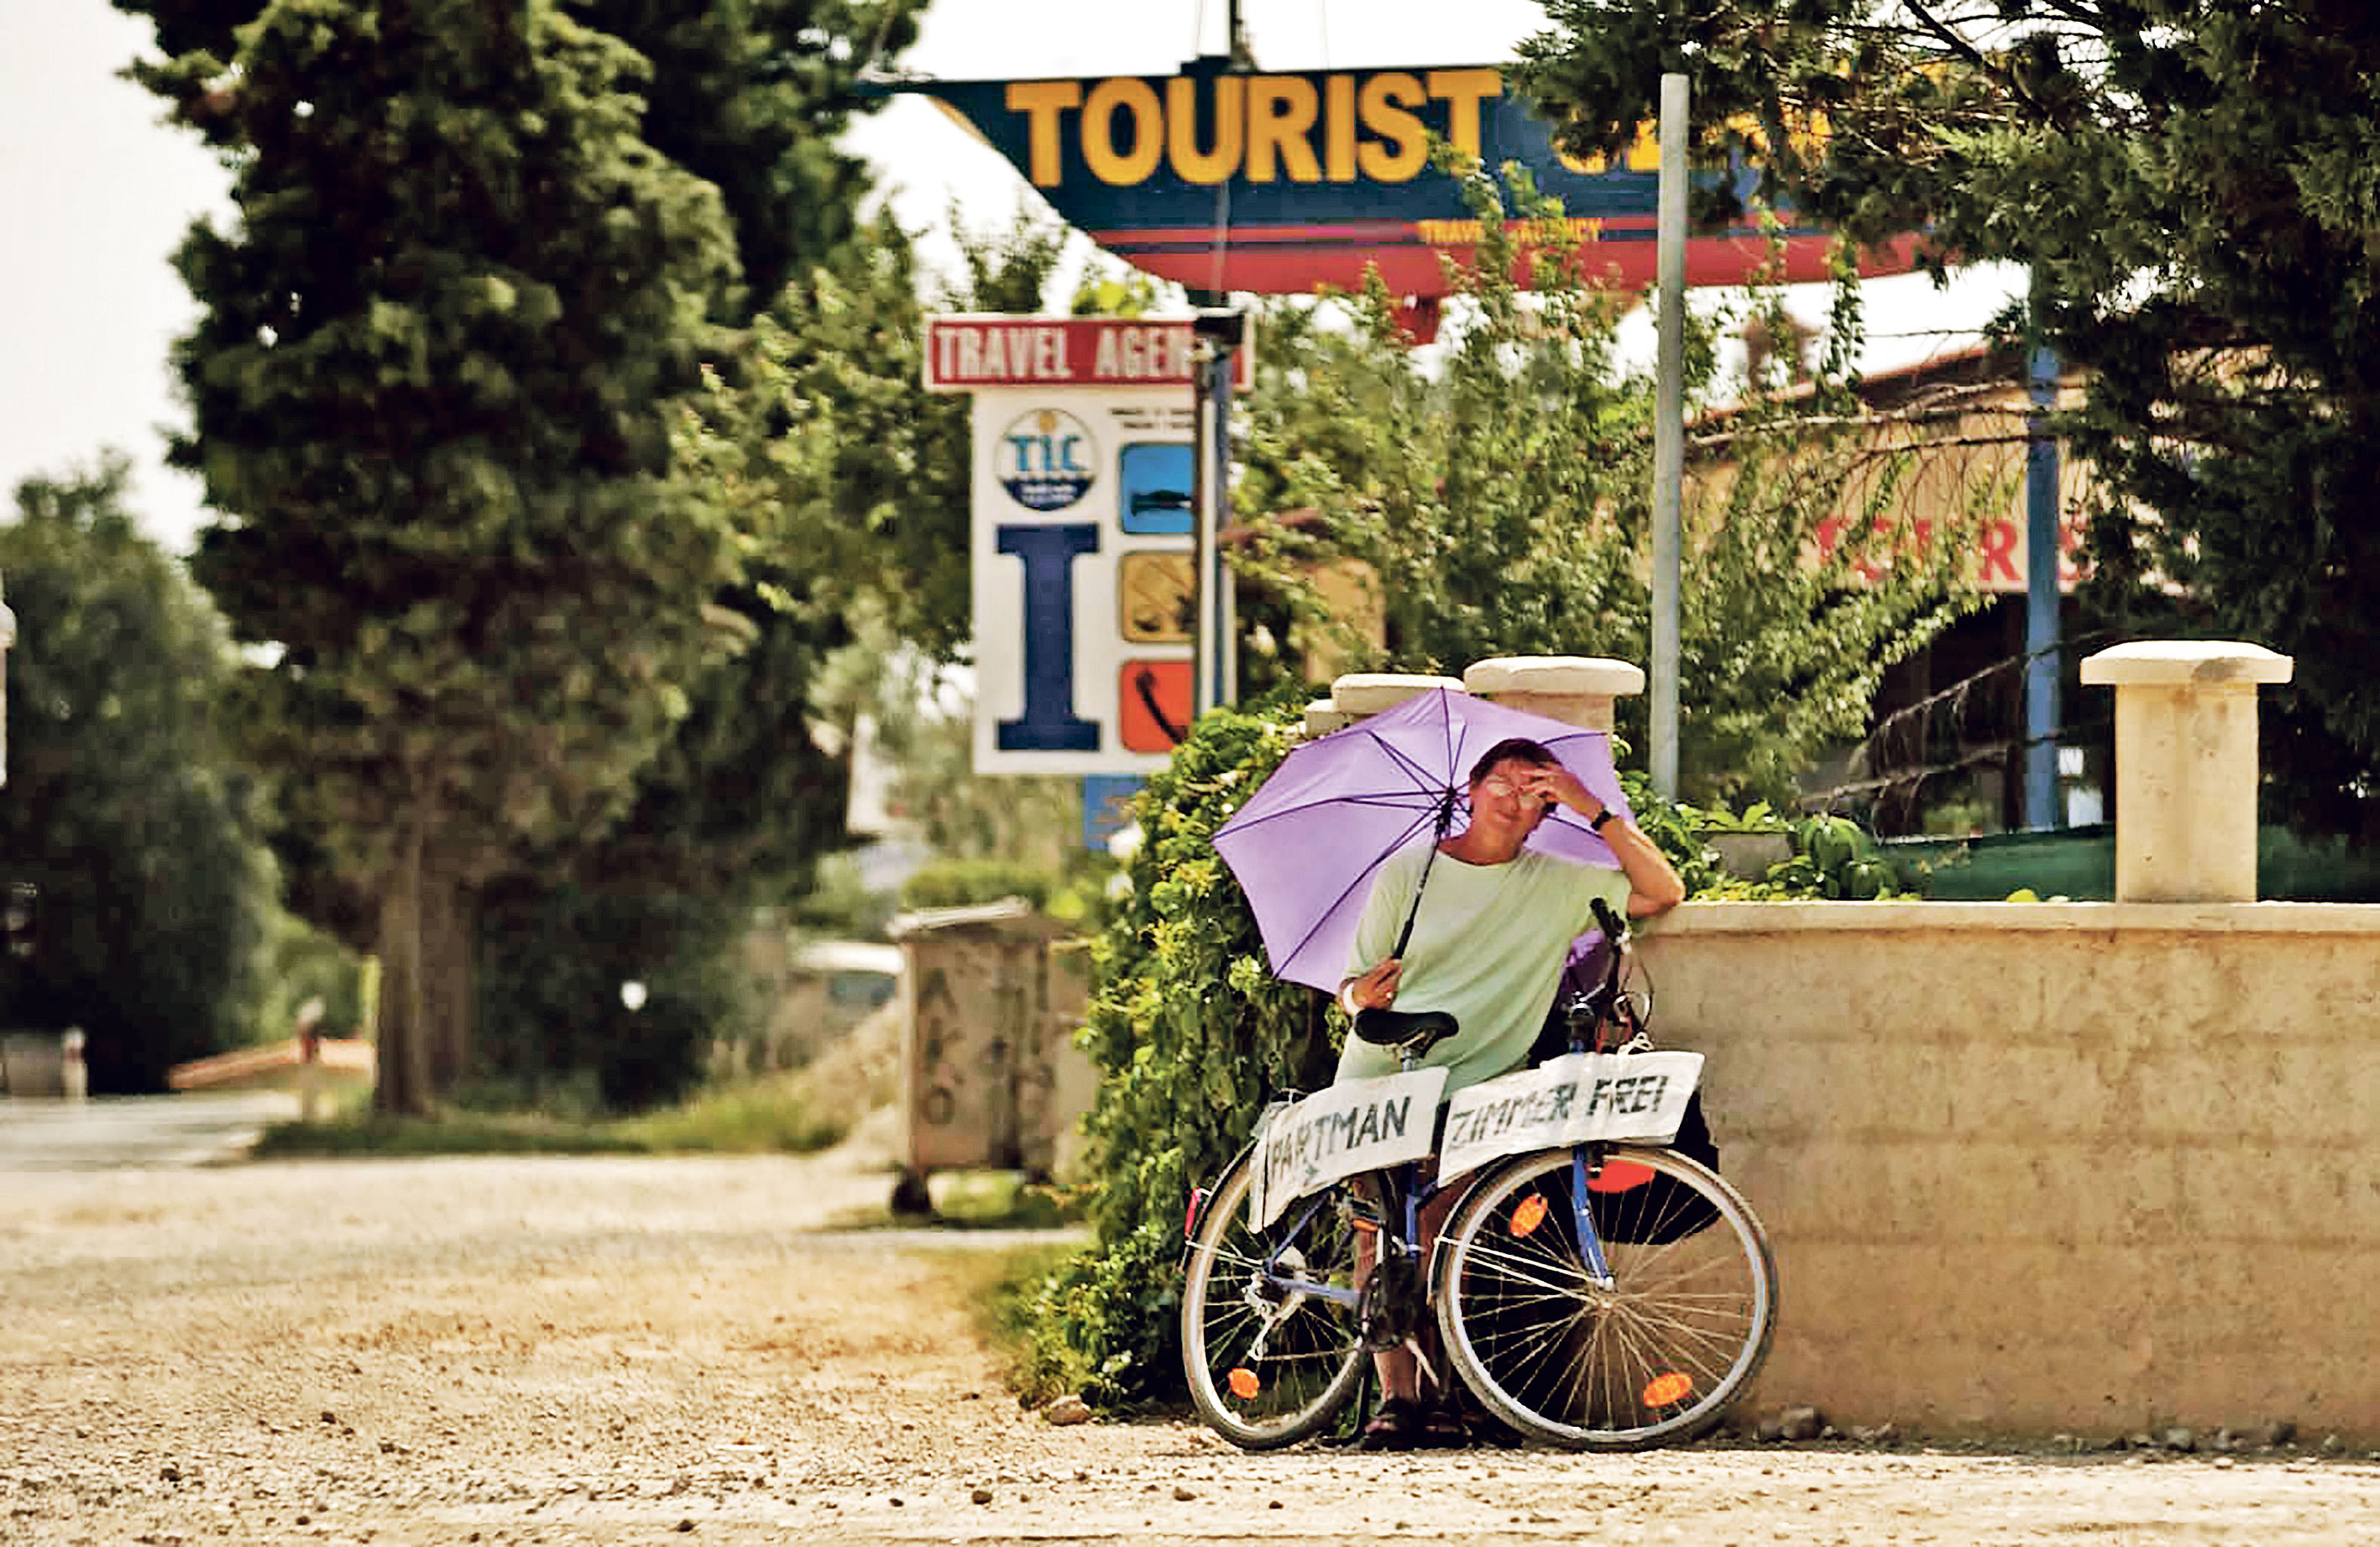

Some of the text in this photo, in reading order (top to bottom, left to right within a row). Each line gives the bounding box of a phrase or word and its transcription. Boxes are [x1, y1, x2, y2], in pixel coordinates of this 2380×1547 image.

[1006, 70, 1501, 187] TOURIST
[935, 326, 1074, 378] TRAVEL
[1451, 1075, 1669, 1148] ZIMMER FREI
